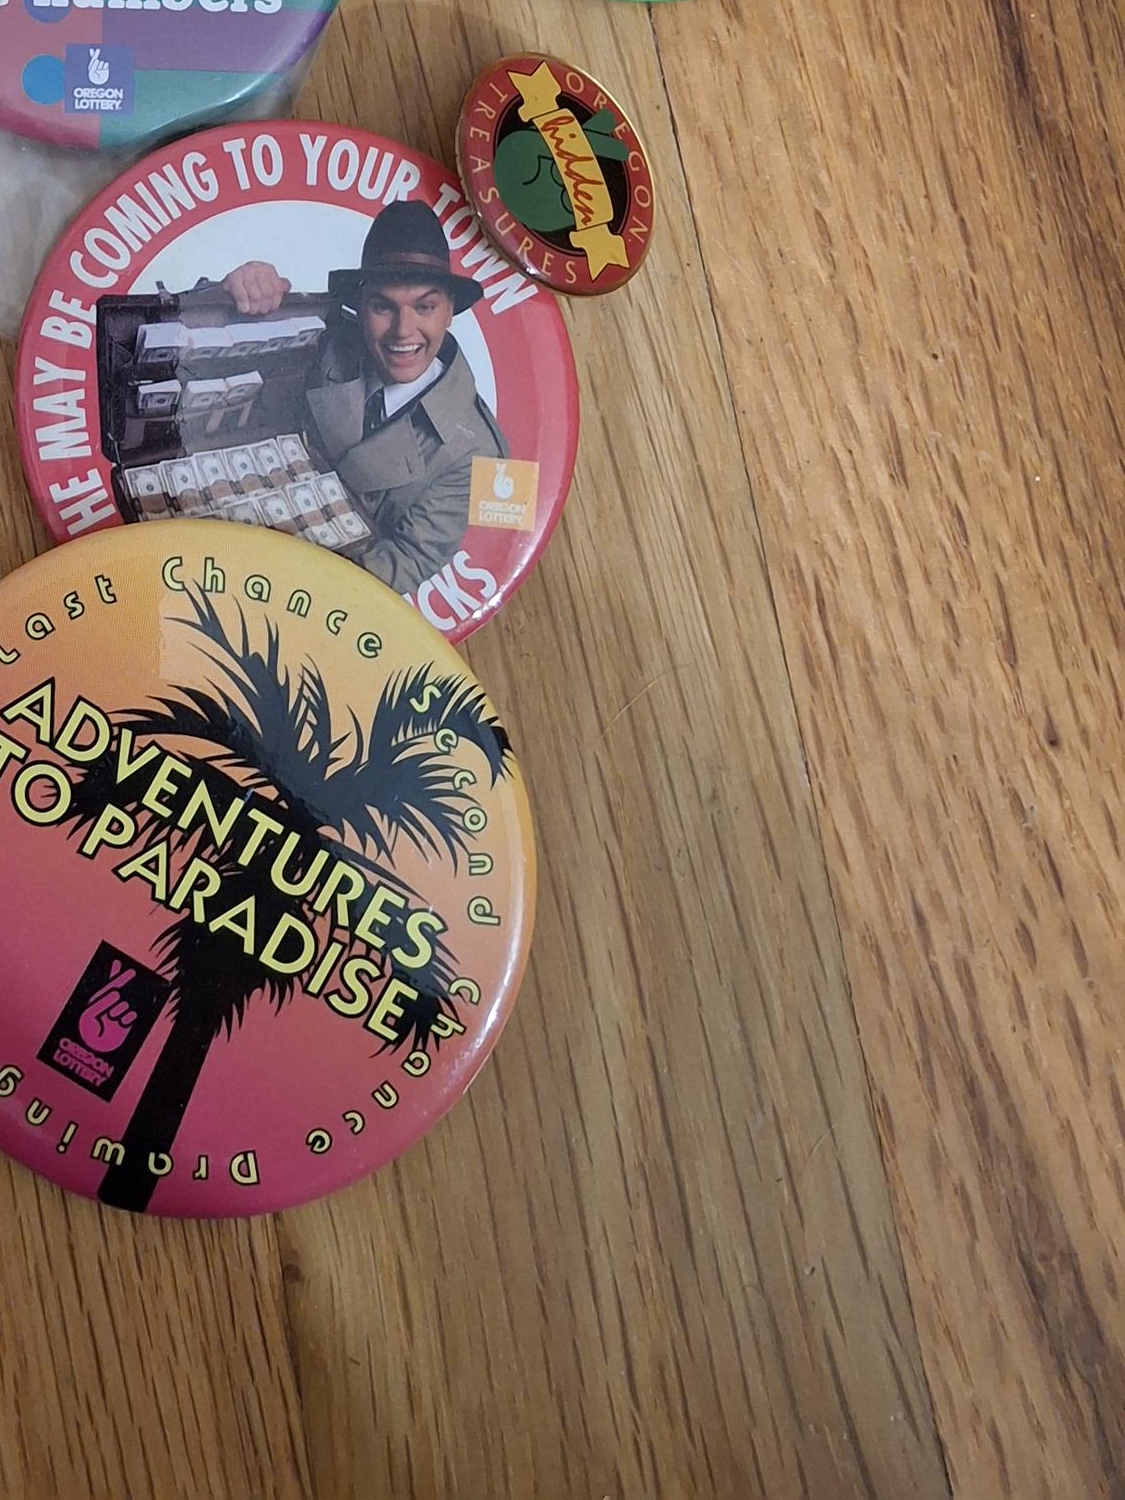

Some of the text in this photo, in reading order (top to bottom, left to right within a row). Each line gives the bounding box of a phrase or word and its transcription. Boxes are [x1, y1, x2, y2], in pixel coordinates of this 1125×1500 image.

[73, 86, 124, 99] OREGON
[74, 98, 123, 111] LOTTERY
[468, 81, 578, 285] TREASURES
[540, 114, 605, 227] hidden
[32, 132, 541, 536] HE MAY BE COMING TO YOUR TOWN
[161, 554, 384, 660] Chance
[402, 549, 497, 631] CKS
[1, 675, 449, 973] ADVENTURES
[407, 680, 503, 928] Second
[79, 803, 420, 1044] PARADISE
[305, 974, 484, 1156] Chance
